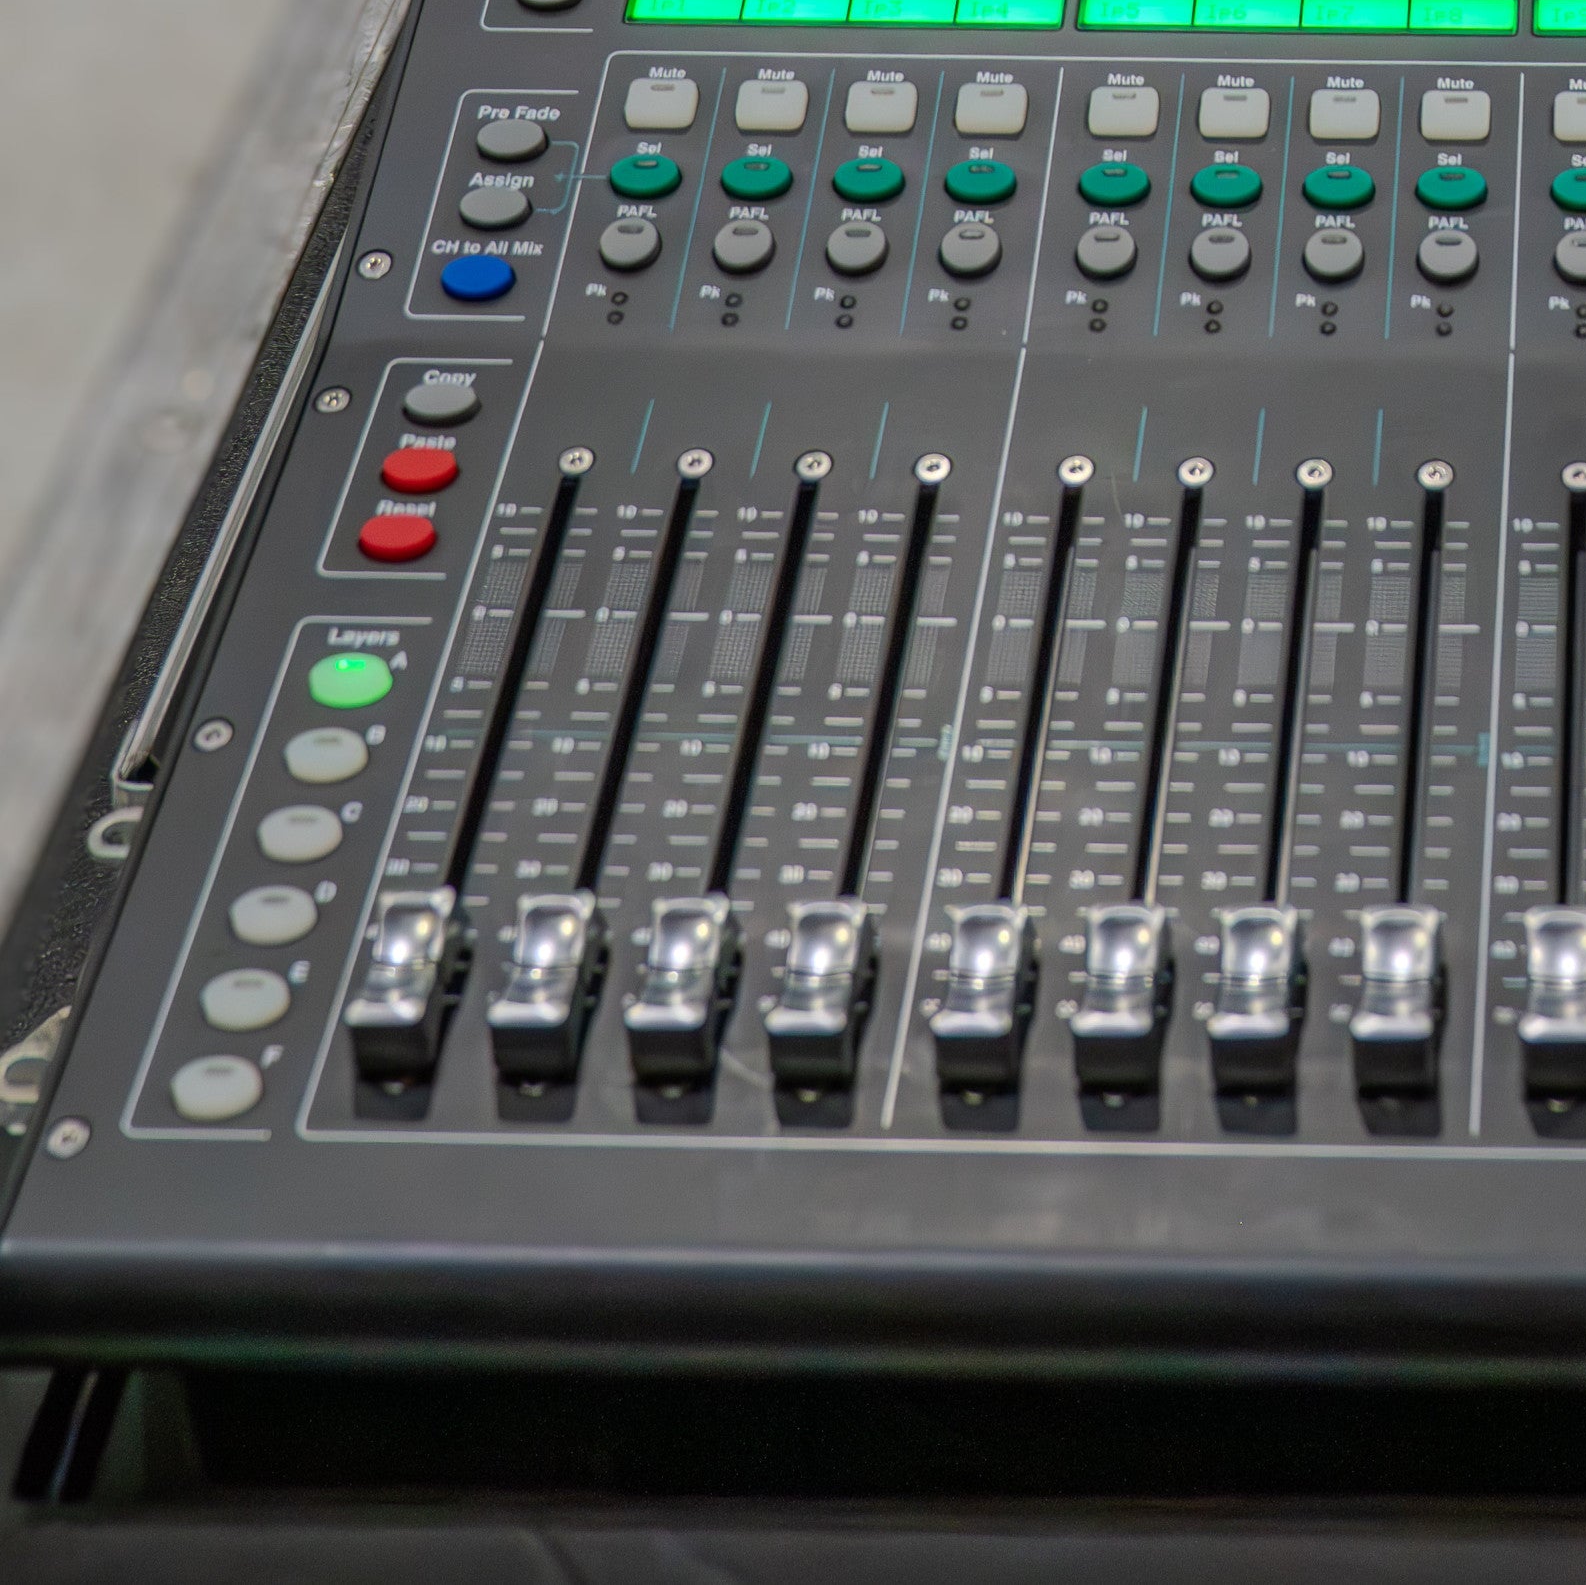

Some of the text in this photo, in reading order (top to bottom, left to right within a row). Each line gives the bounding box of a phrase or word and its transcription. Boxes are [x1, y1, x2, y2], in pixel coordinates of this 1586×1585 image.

[1107, 73, 1145, 86] Mute
[477, 105, 561, 120] Pre Fade
[469, 172, 535, 190] Assign
[1089, 213, 1130, 226] PAFL
[432, 240, 544, 255] CH to All Mix
[328, 628, 400, 647] Layers
